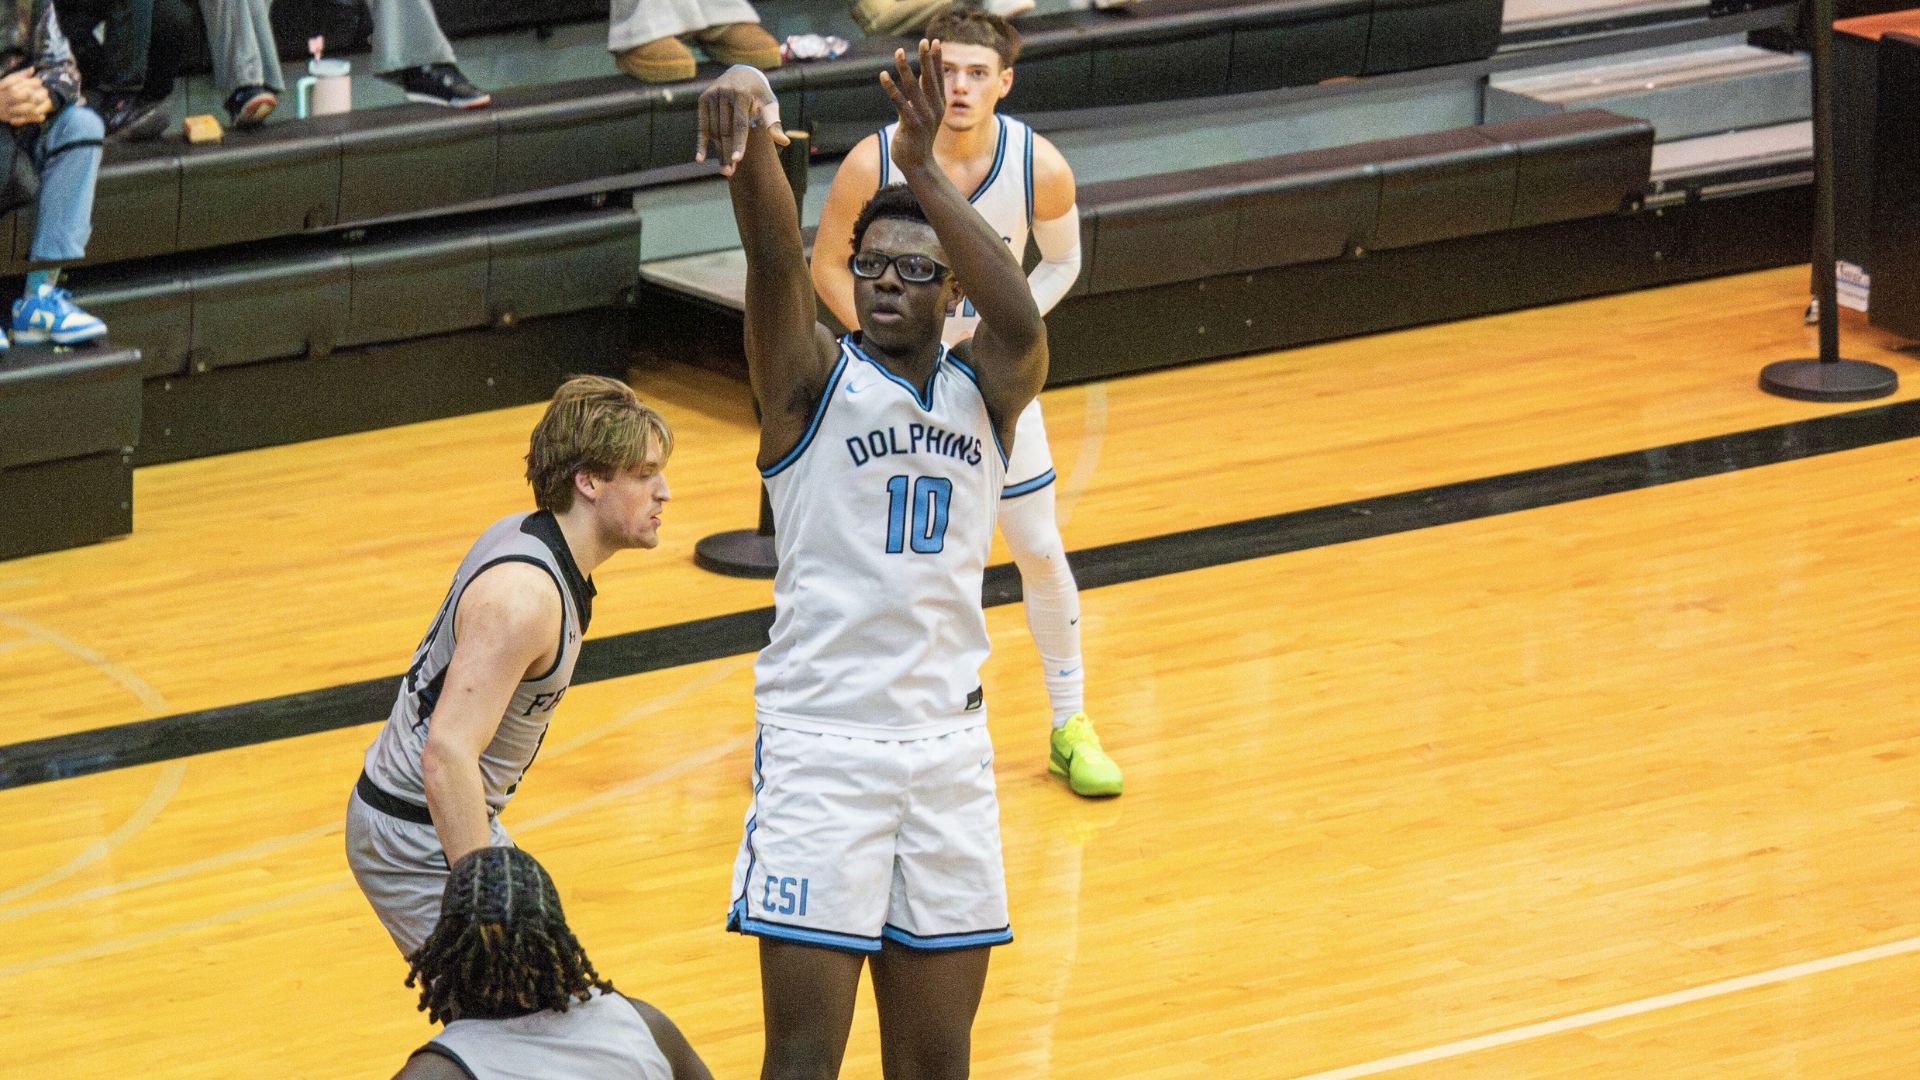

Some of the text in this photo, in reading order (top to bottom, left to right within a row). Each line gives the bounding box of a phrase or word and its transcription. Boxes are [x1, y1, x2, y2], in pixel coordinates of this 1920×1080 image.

[846, 423, 982, 467] DOLPHINS
[885, 475, 953, 554] 10
[762, 875, 809, 916] CSI
